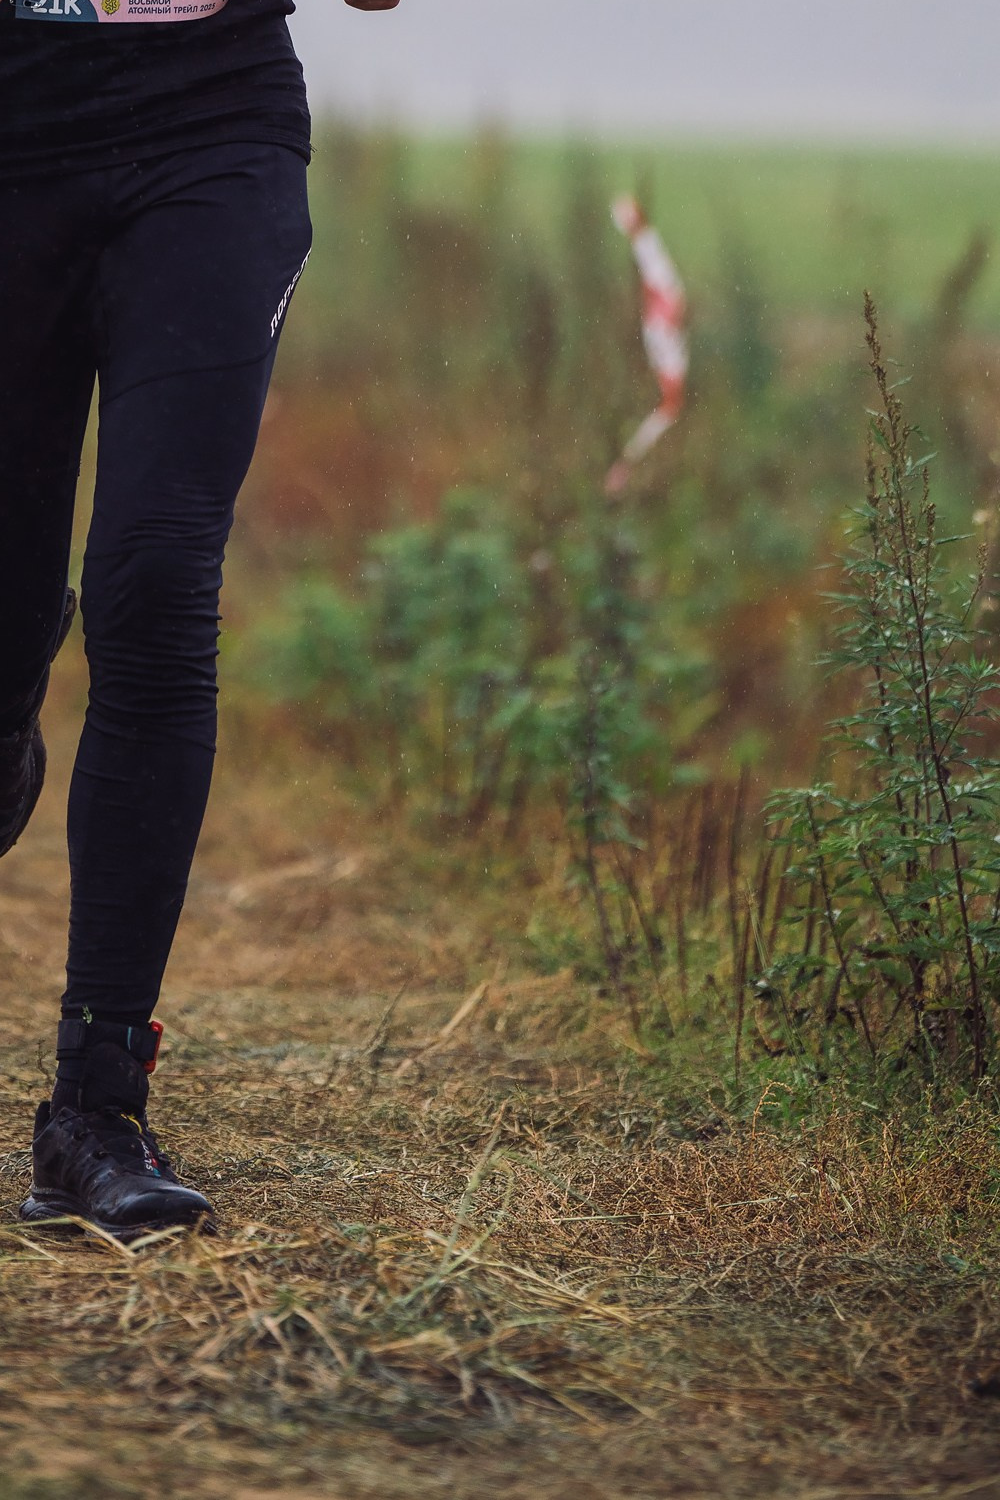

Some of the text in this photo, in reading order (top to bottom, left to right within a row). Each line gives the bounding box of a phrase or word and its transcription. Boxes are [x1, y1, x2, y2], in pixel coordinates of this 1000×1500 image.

[128, 3, 216, 15] АТОМНЫЙ ТРЕЙЛ 2025
